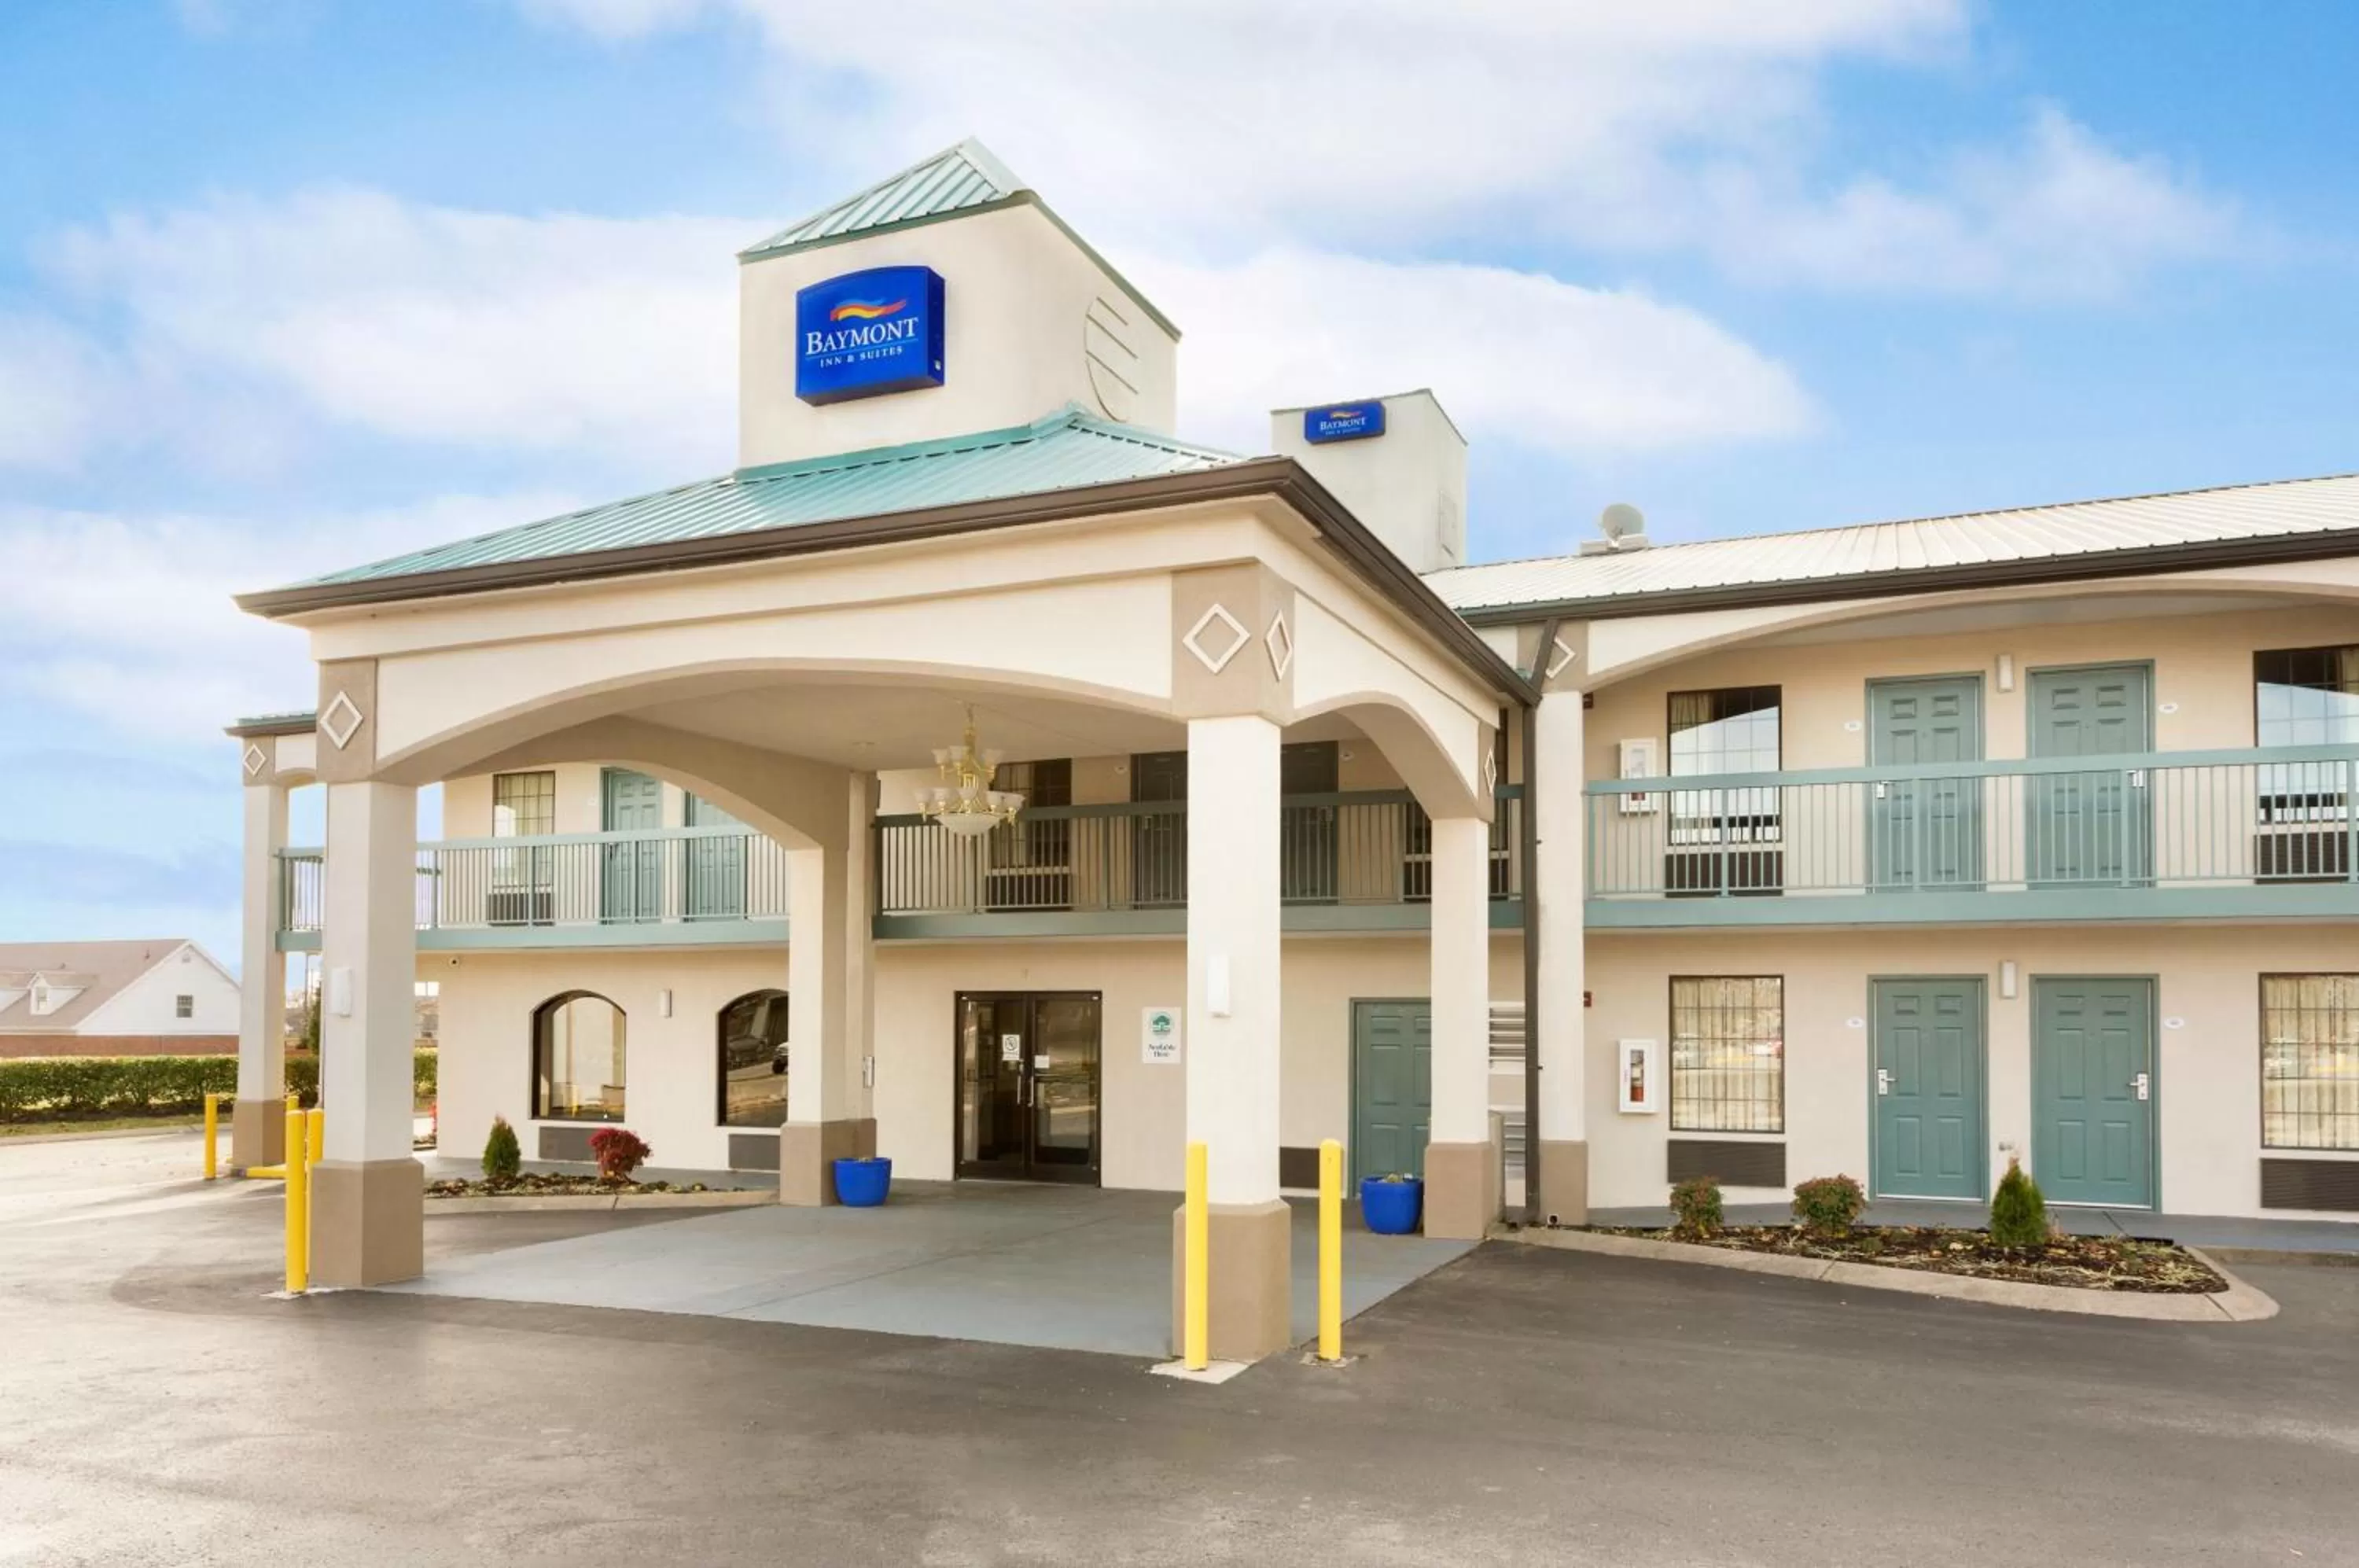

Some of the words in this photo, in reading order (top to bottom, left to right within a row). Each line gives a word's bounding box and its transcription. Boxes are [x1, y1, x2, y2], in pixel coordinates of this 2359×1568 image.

[805, 316, 919, 355] BAYMONT
[820, 356, 842, 368] INN
[859, 345, 903, 360] SUITES
